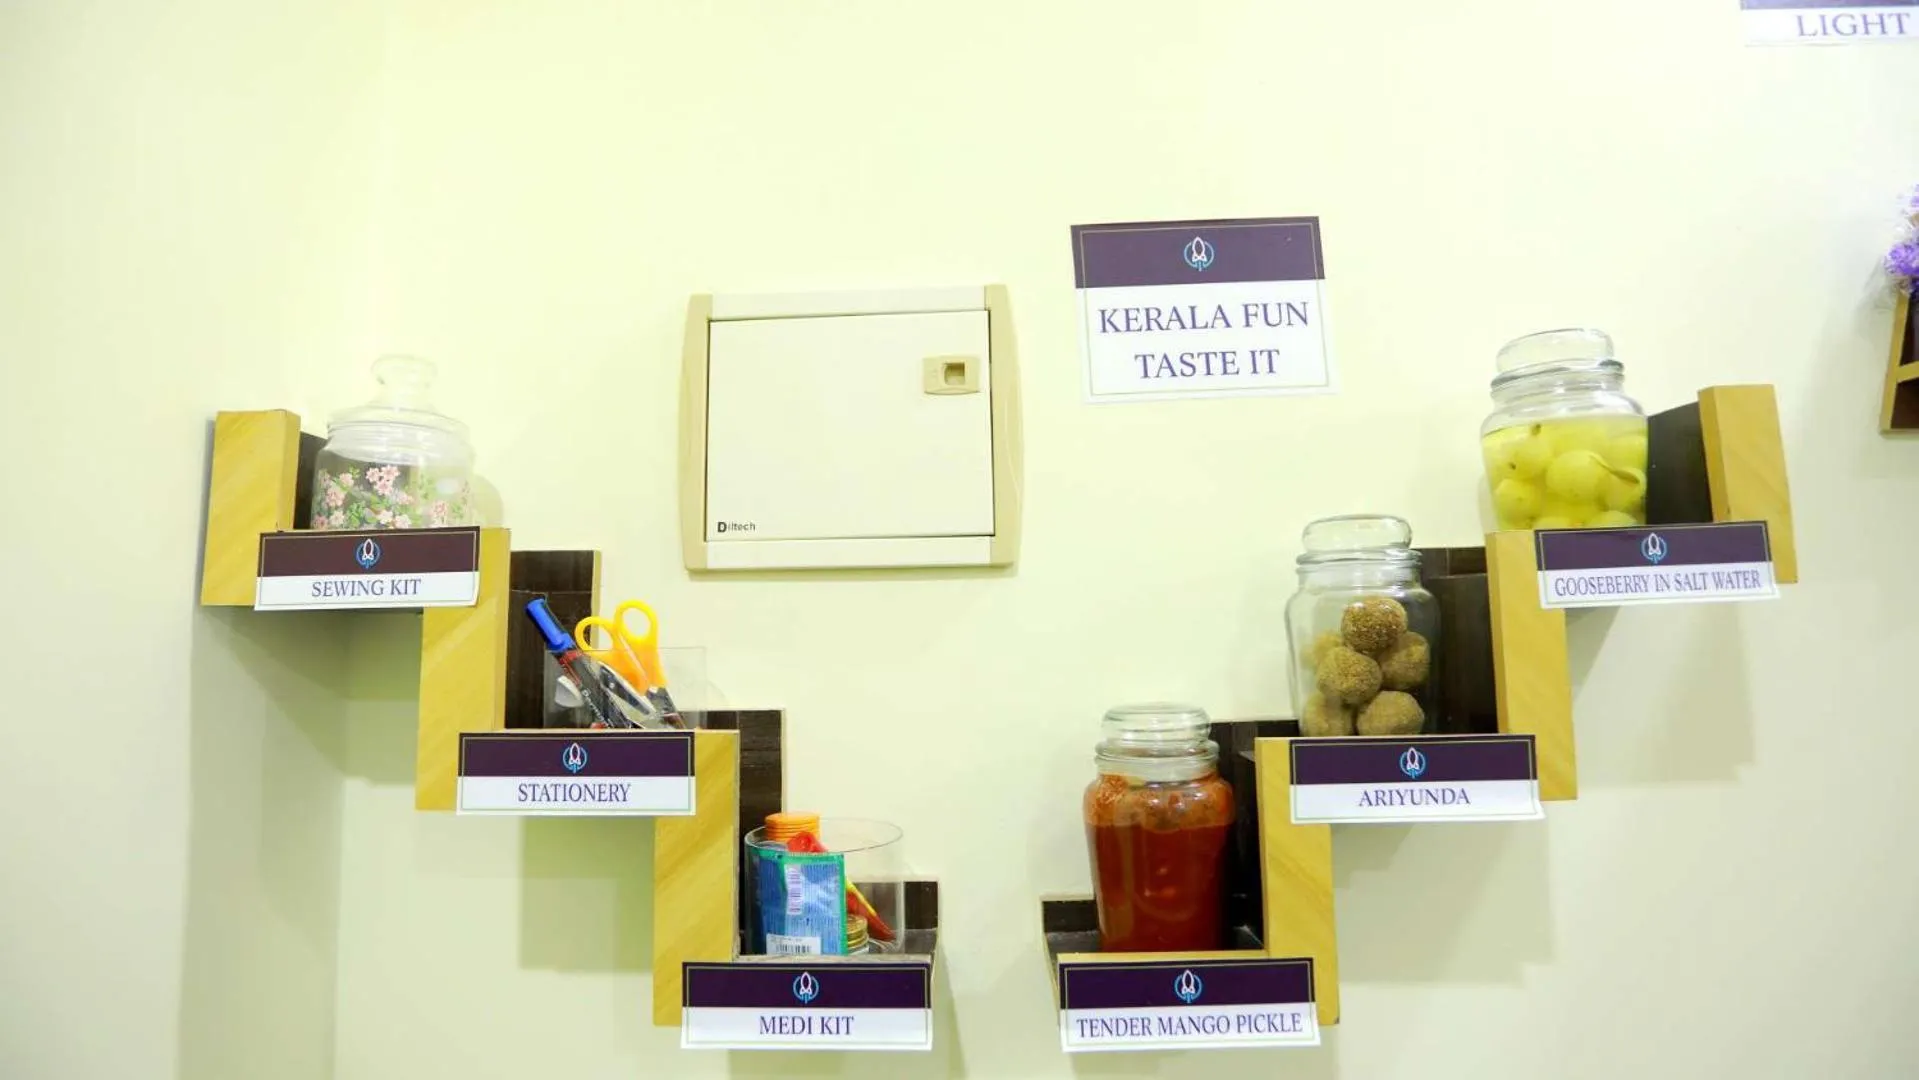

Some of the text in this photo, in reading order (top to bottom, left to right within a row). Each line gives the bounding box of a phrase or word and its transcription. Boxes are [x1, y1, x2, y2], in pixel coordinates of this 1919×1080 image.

[1795, 13, 1910, 37] LIGHT
[1098, 301, 1309, 333] KERALA FUN
[1134, 349, 1280, 378] TASTE IT
[717, 521, 756, 533] Diltech
[312, 579, 421, 597] SEWING KIT
[1554, 569, 1761, 596] GOOSEBERRY IN SALT WATER
[518, 783, 631, 802] STATIONERY
[1359, 788, 1471, 806] ARIYUNDA
[760, 1016, 854, 1035] MEDI KIT
[1076, 1013, 1303, 1037] TENDER MANGO PICKLE
